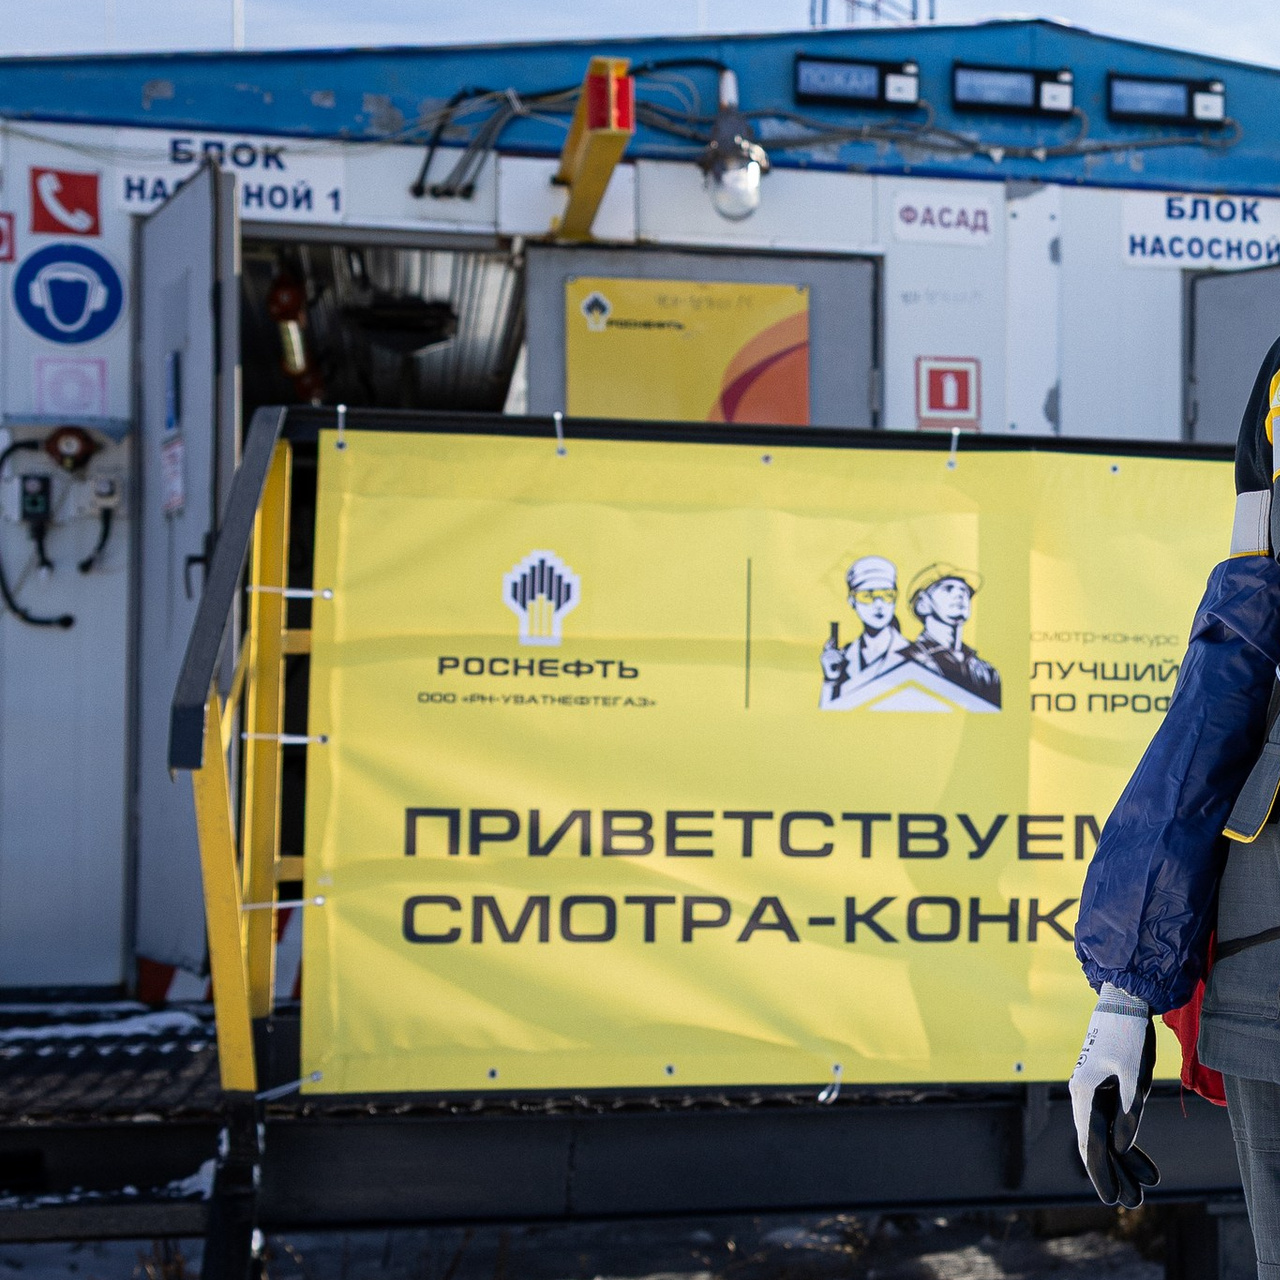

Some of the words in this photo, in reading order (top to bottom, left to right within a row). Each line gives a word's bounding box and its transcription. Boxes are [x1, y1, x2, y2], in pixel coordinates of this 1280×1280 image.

[170, 138, 286, 170] БЛОК
[124, 176, 313, 211] НАНОЙ
[328, 188, 341, 211] 1
[899, 205, 989, 234] ФАСАД
[1166, 196, 1260, 223] БЛОК
[437, 656, 640, 679] РОСНЕФТЬ
[1030, 659, 1179, 682] ЛУЧШИЙ
[417, 691, 457, 704] ООО
[1031, 694, 1076, 712] ПО
[402, 894, 1080, 944] СМОТРА-КОНК
